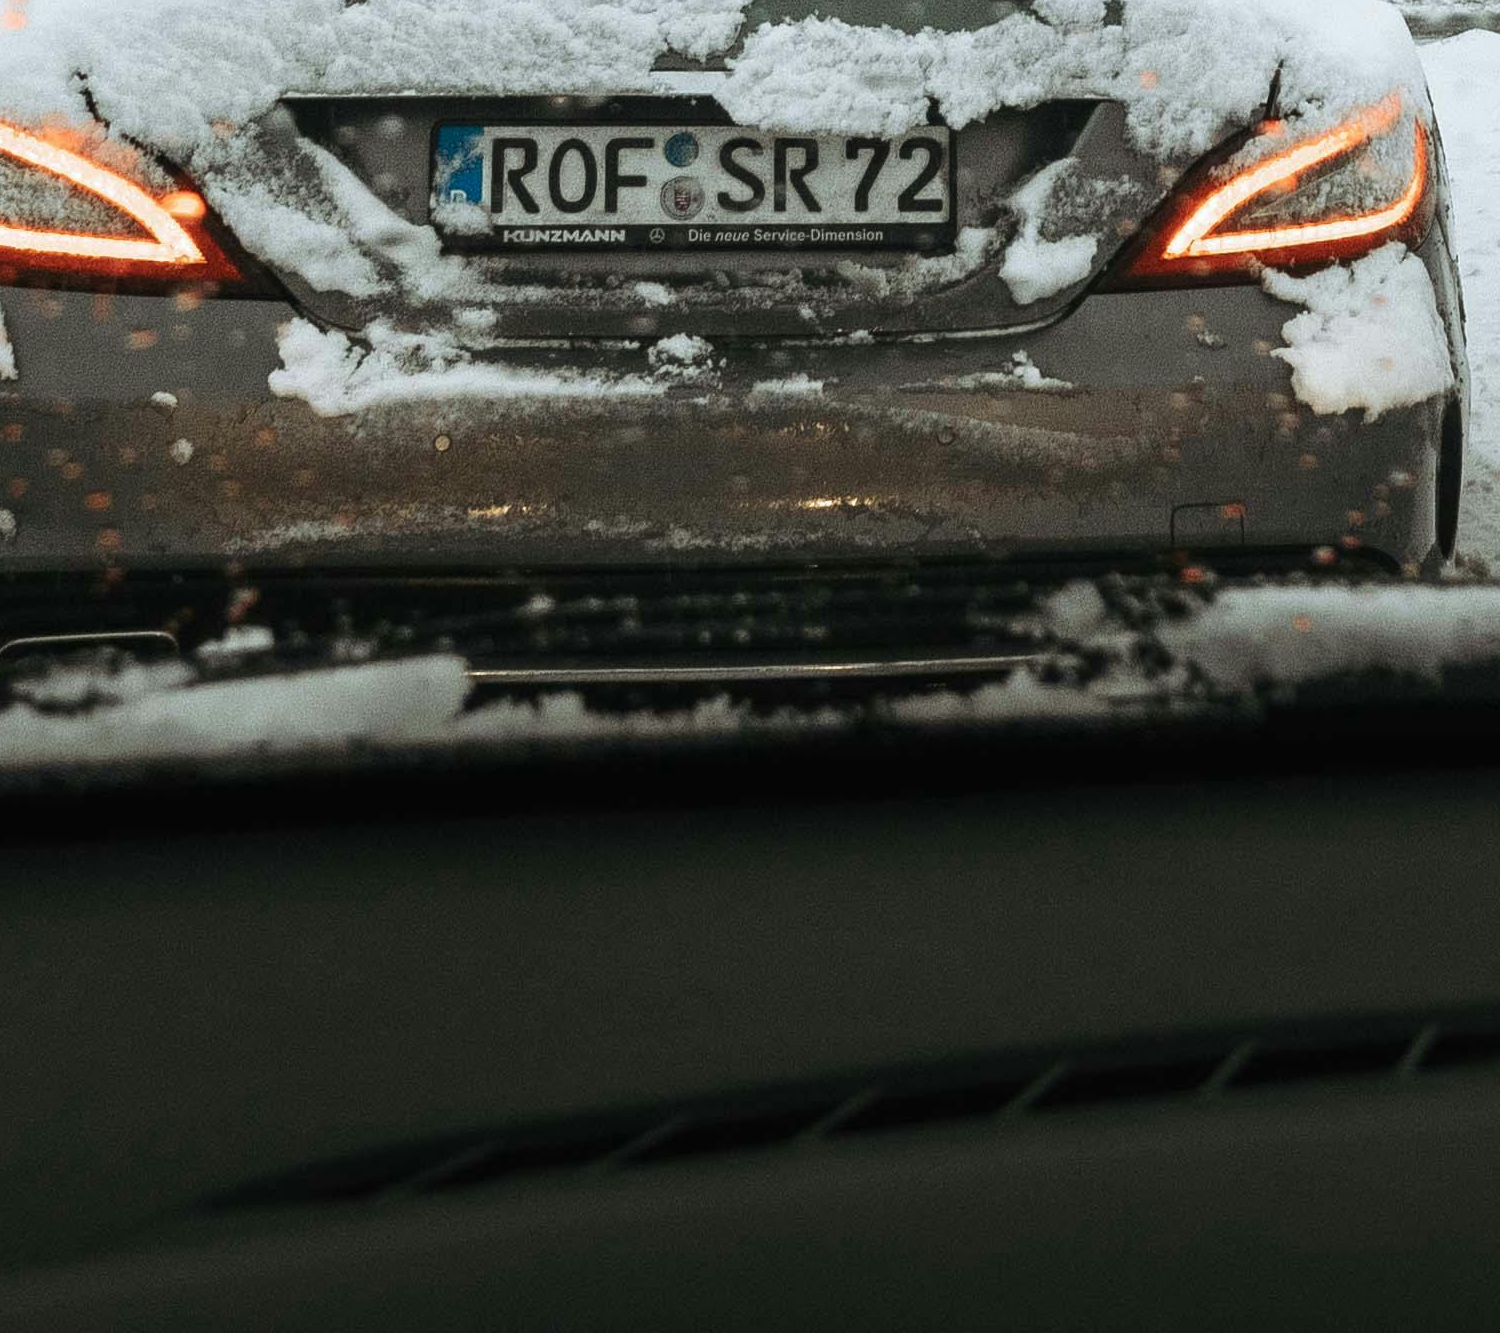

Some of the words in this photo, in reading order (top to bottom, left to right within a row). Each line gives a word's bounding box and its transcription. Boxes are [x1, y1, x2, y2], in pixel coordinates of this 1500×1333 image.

[490, 137, 655, 214] ROF
[717, 136, 822, 213] SR
[845, 136, 944, 213] 72
[503, 229, 626, 243] KUNZMANN
[688, 228, 711, 242] Die
[714, 230, 750, 242] neue
[753, 228, 884, 242] Service-Dimension
